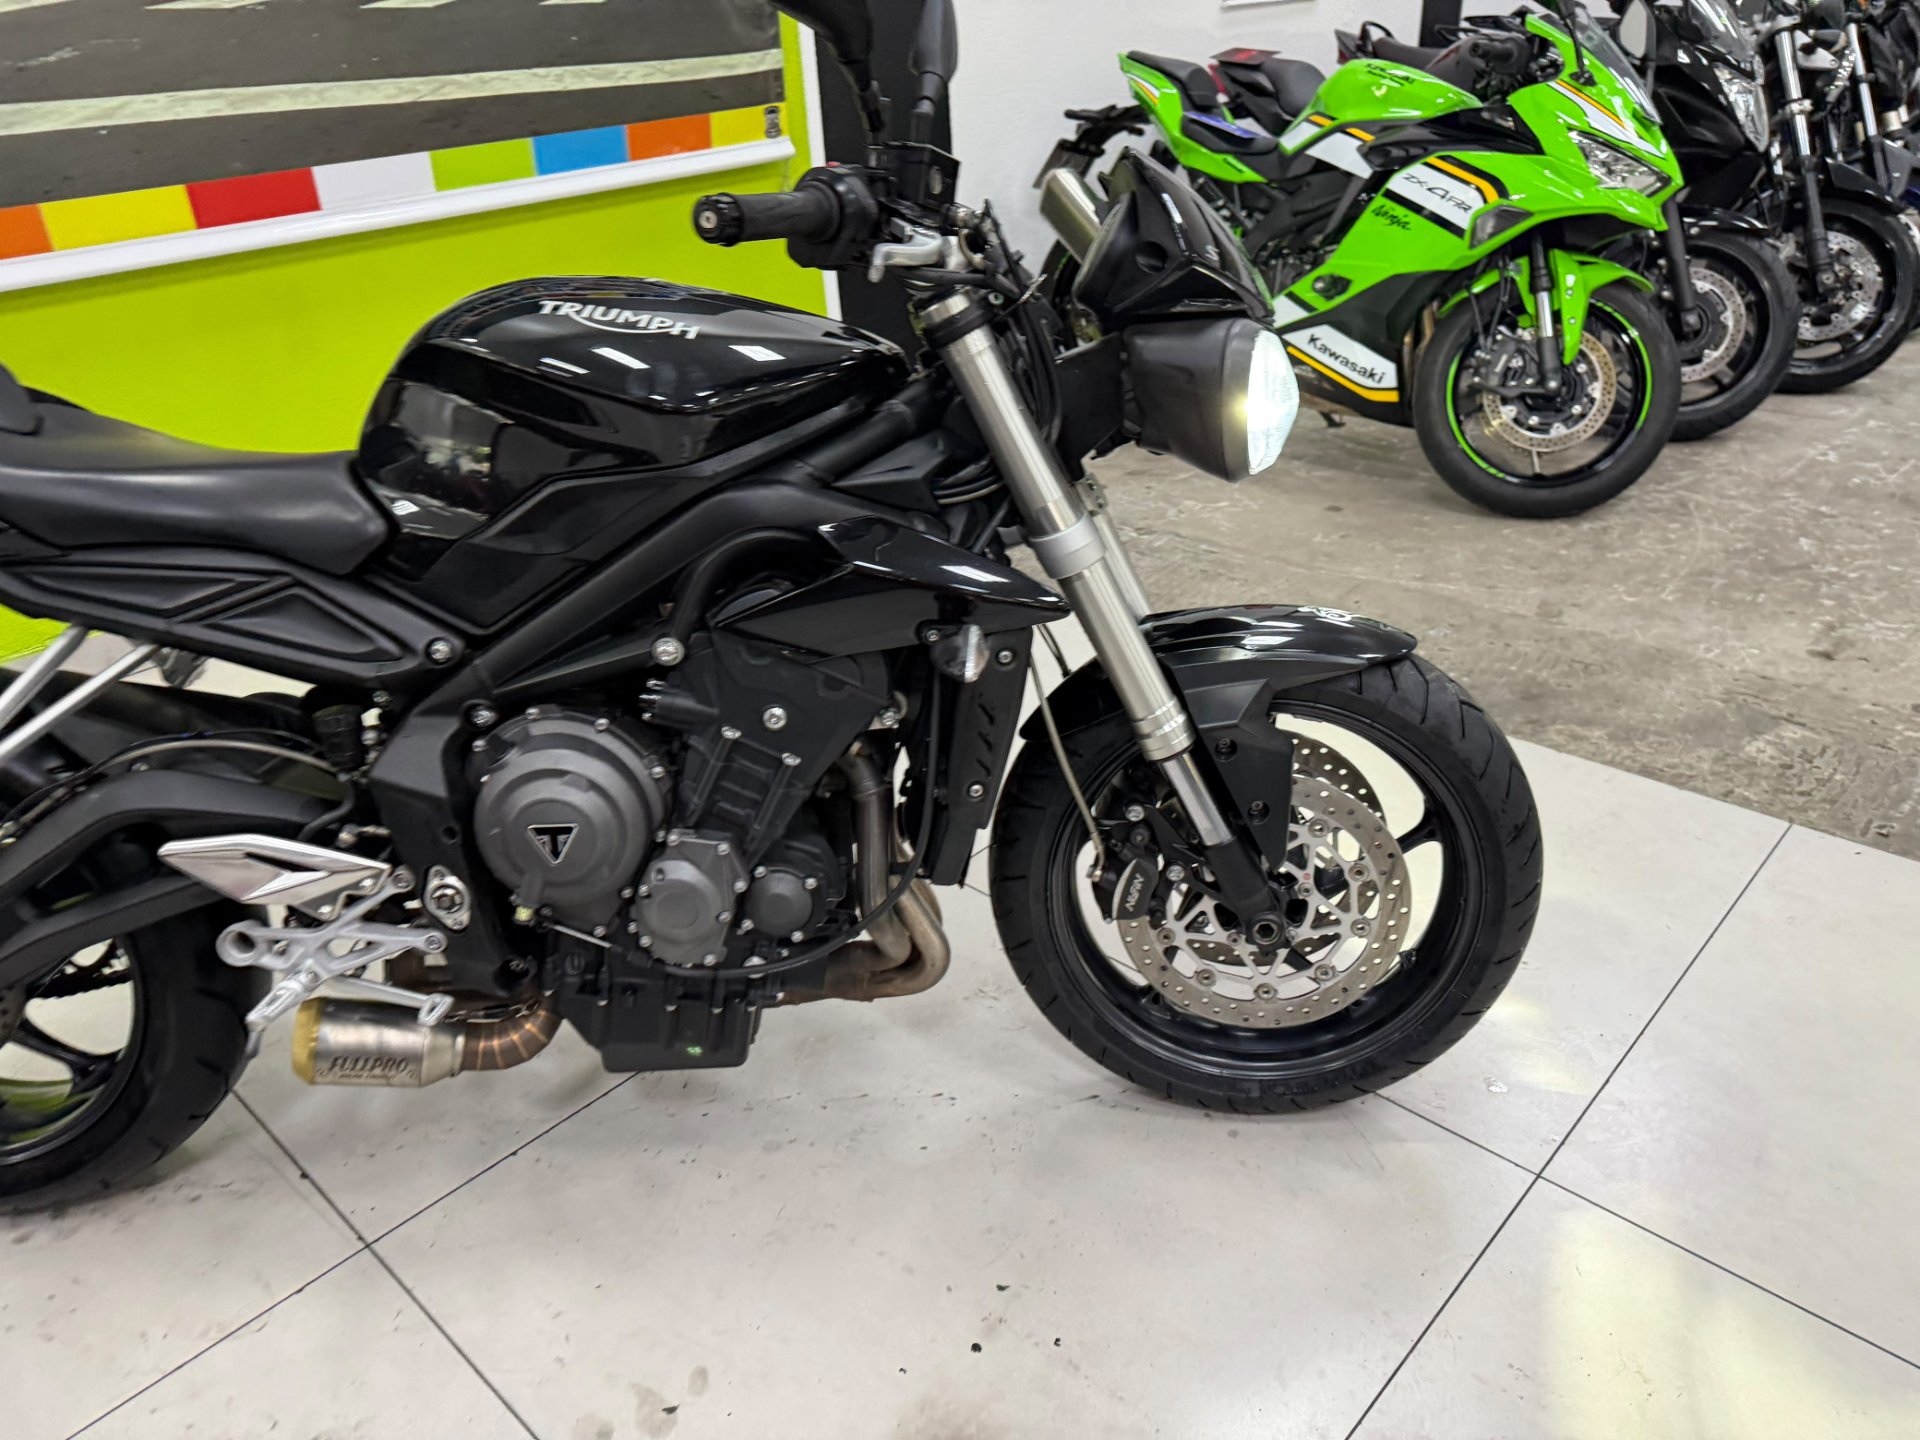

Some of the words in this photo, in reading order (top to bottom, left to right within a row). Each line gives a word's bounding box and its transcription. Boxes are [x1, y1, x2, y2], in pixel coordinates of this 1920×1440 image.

[1371, 204, 1411, 231] Ninja
[539, 300, 701, 340] TRIUMPH
[1307, 333, 1386, 385] Kawasaki
[328, 1056, 409, 1074] FULLPRO
